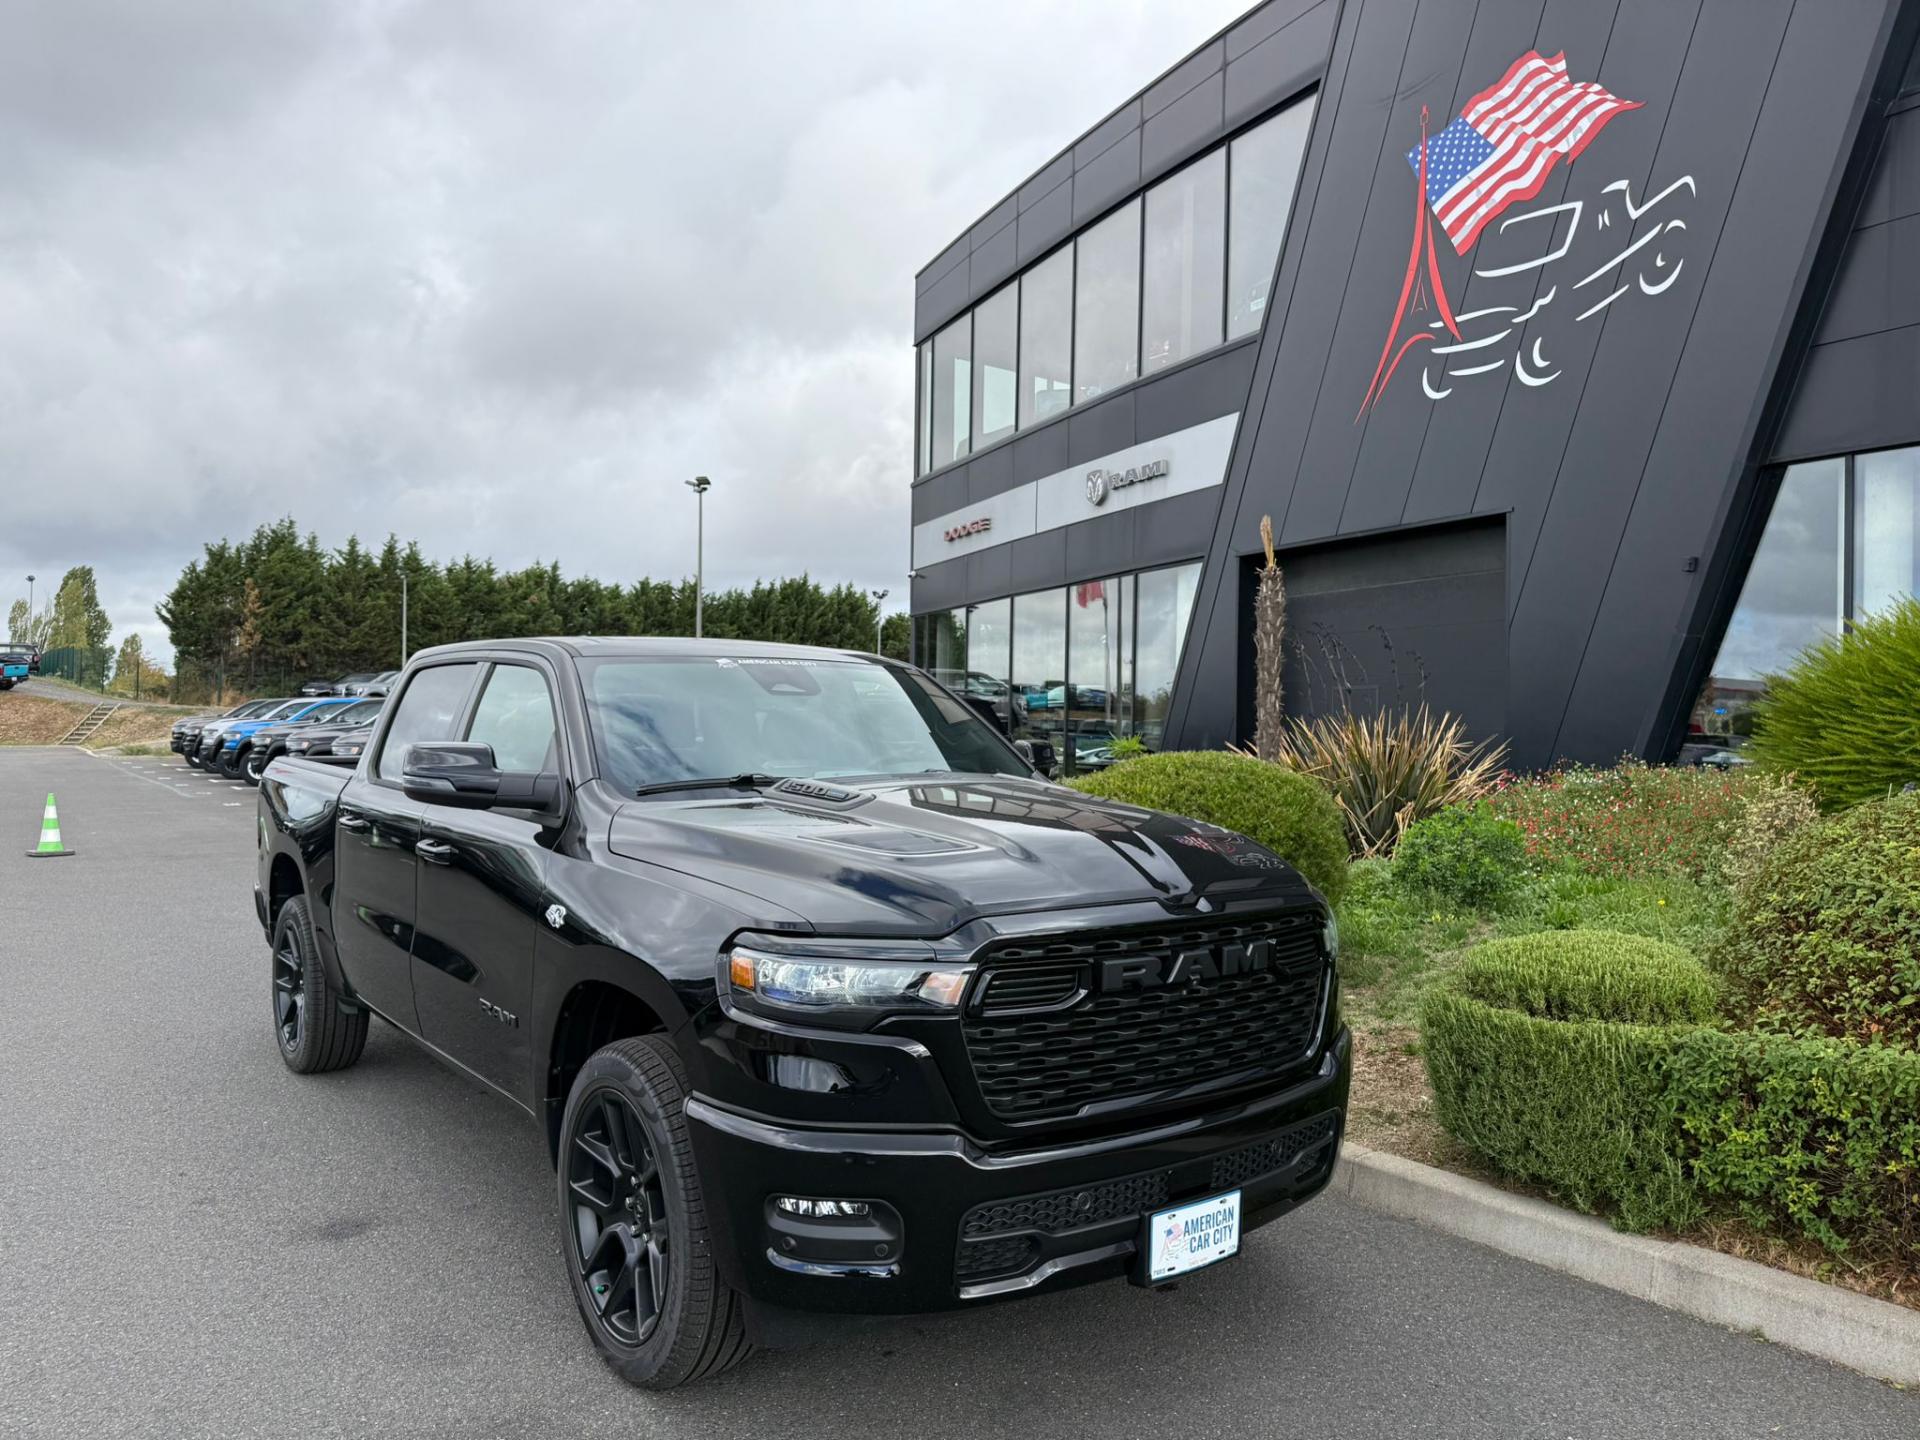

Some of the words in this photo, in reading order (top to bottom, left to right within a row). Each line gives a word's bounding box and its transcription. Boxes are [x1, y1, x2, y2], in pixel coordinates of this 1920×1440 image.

[1108, 459, 1169, 490] RAM
[943, 518, 991, 542] DODGE
[1101, 939, 1270, 993] RAM
[1183, 1205, 1235, 1238] AMERICAN
[1189, 1233, 1210, 1254] CAR
[1213, 1223, 1234, 1245] CITY
